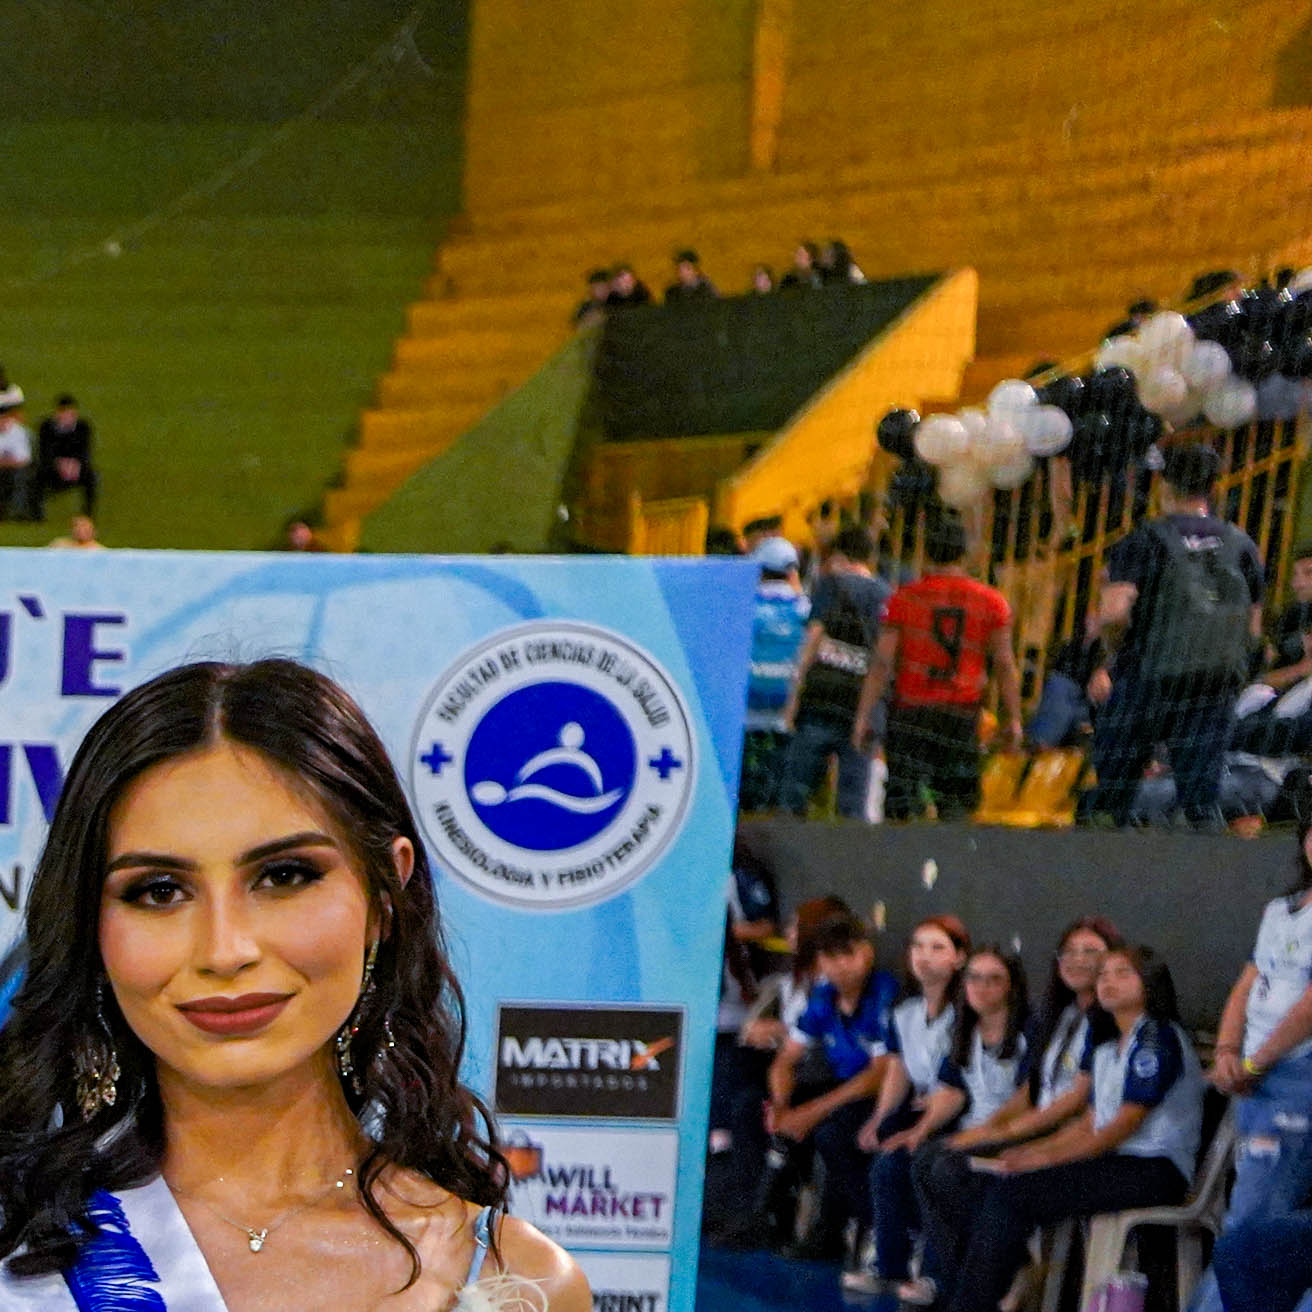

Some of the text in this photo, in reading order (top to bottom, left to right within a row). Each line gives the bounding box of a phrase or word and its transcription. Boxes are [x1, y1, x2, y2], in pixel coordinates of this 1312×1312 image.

[437, 659, 500, 723] FACULTAD
[500, 649, 521, 670] DE
[526, 641, 594, 665] CIENCIAS
[502, 1036, 666, 1071] MATRIX
[547, 1166, 617, 1189] WILL
[546, 1192, 666, 1218] MARKET
